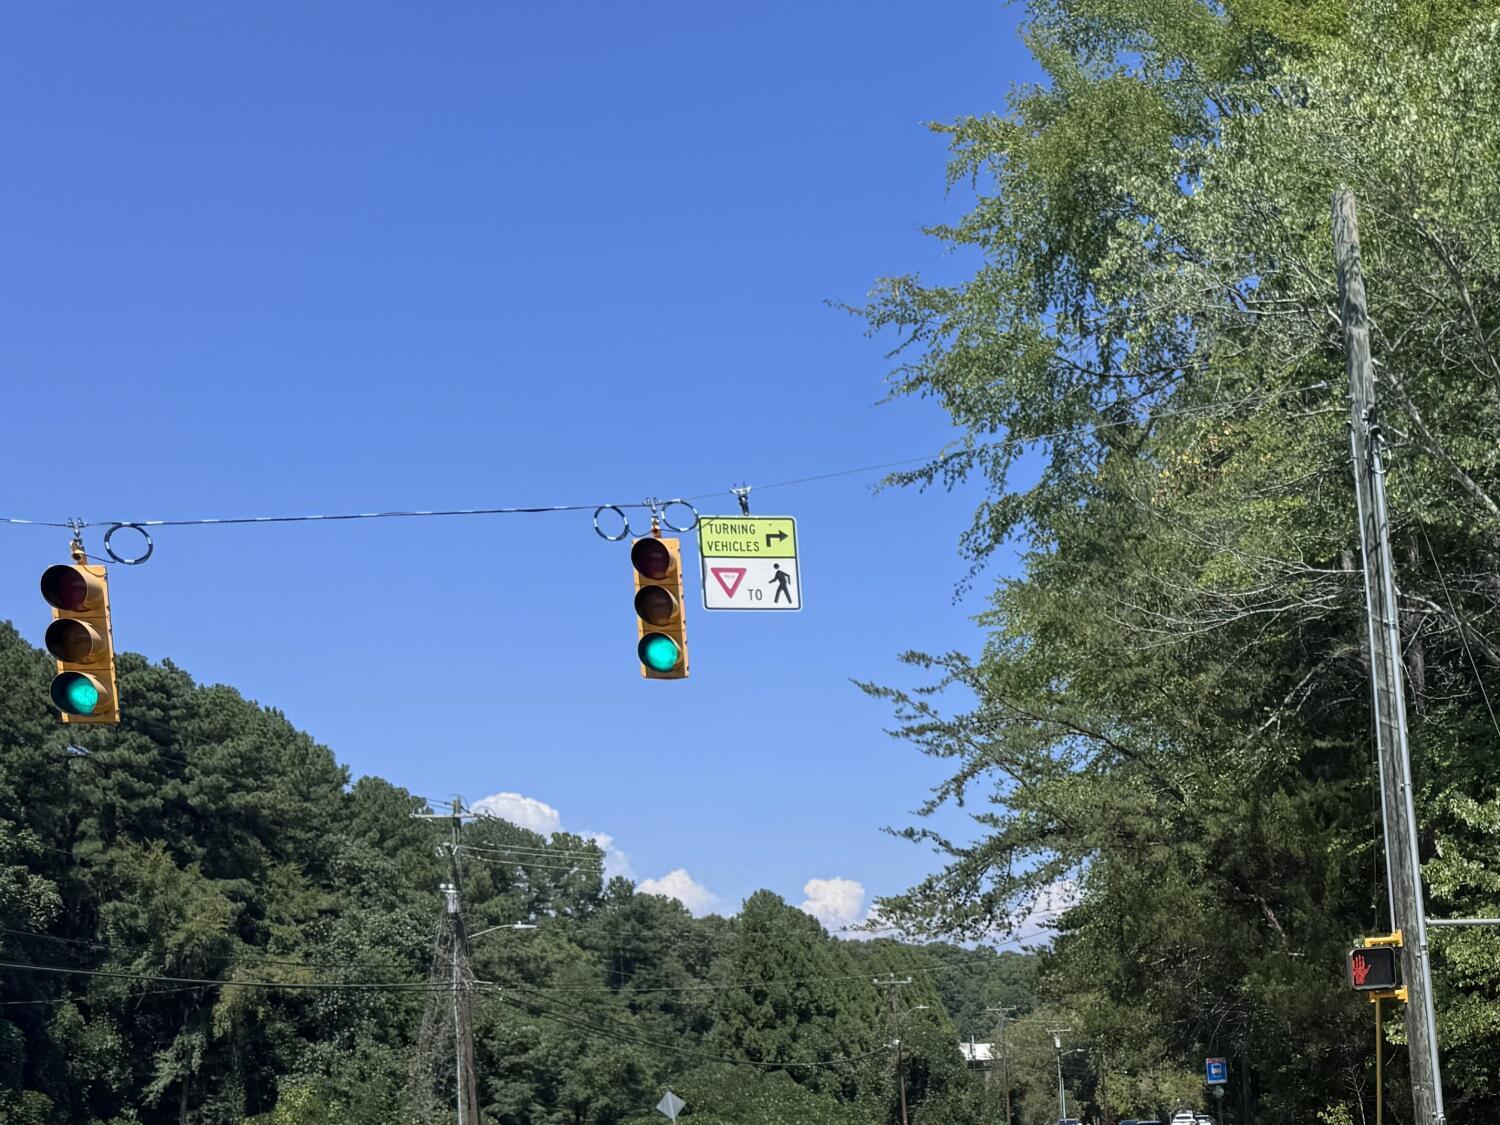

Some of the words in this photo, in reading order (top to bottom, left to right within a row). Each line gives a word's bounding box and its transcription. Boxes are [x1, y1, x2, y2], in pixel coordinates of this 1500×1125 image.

[709, 523, 756, 535] TURNING
[707, 540, 760, 552] VEHICLES
[747, 588, 763, 601] TO
